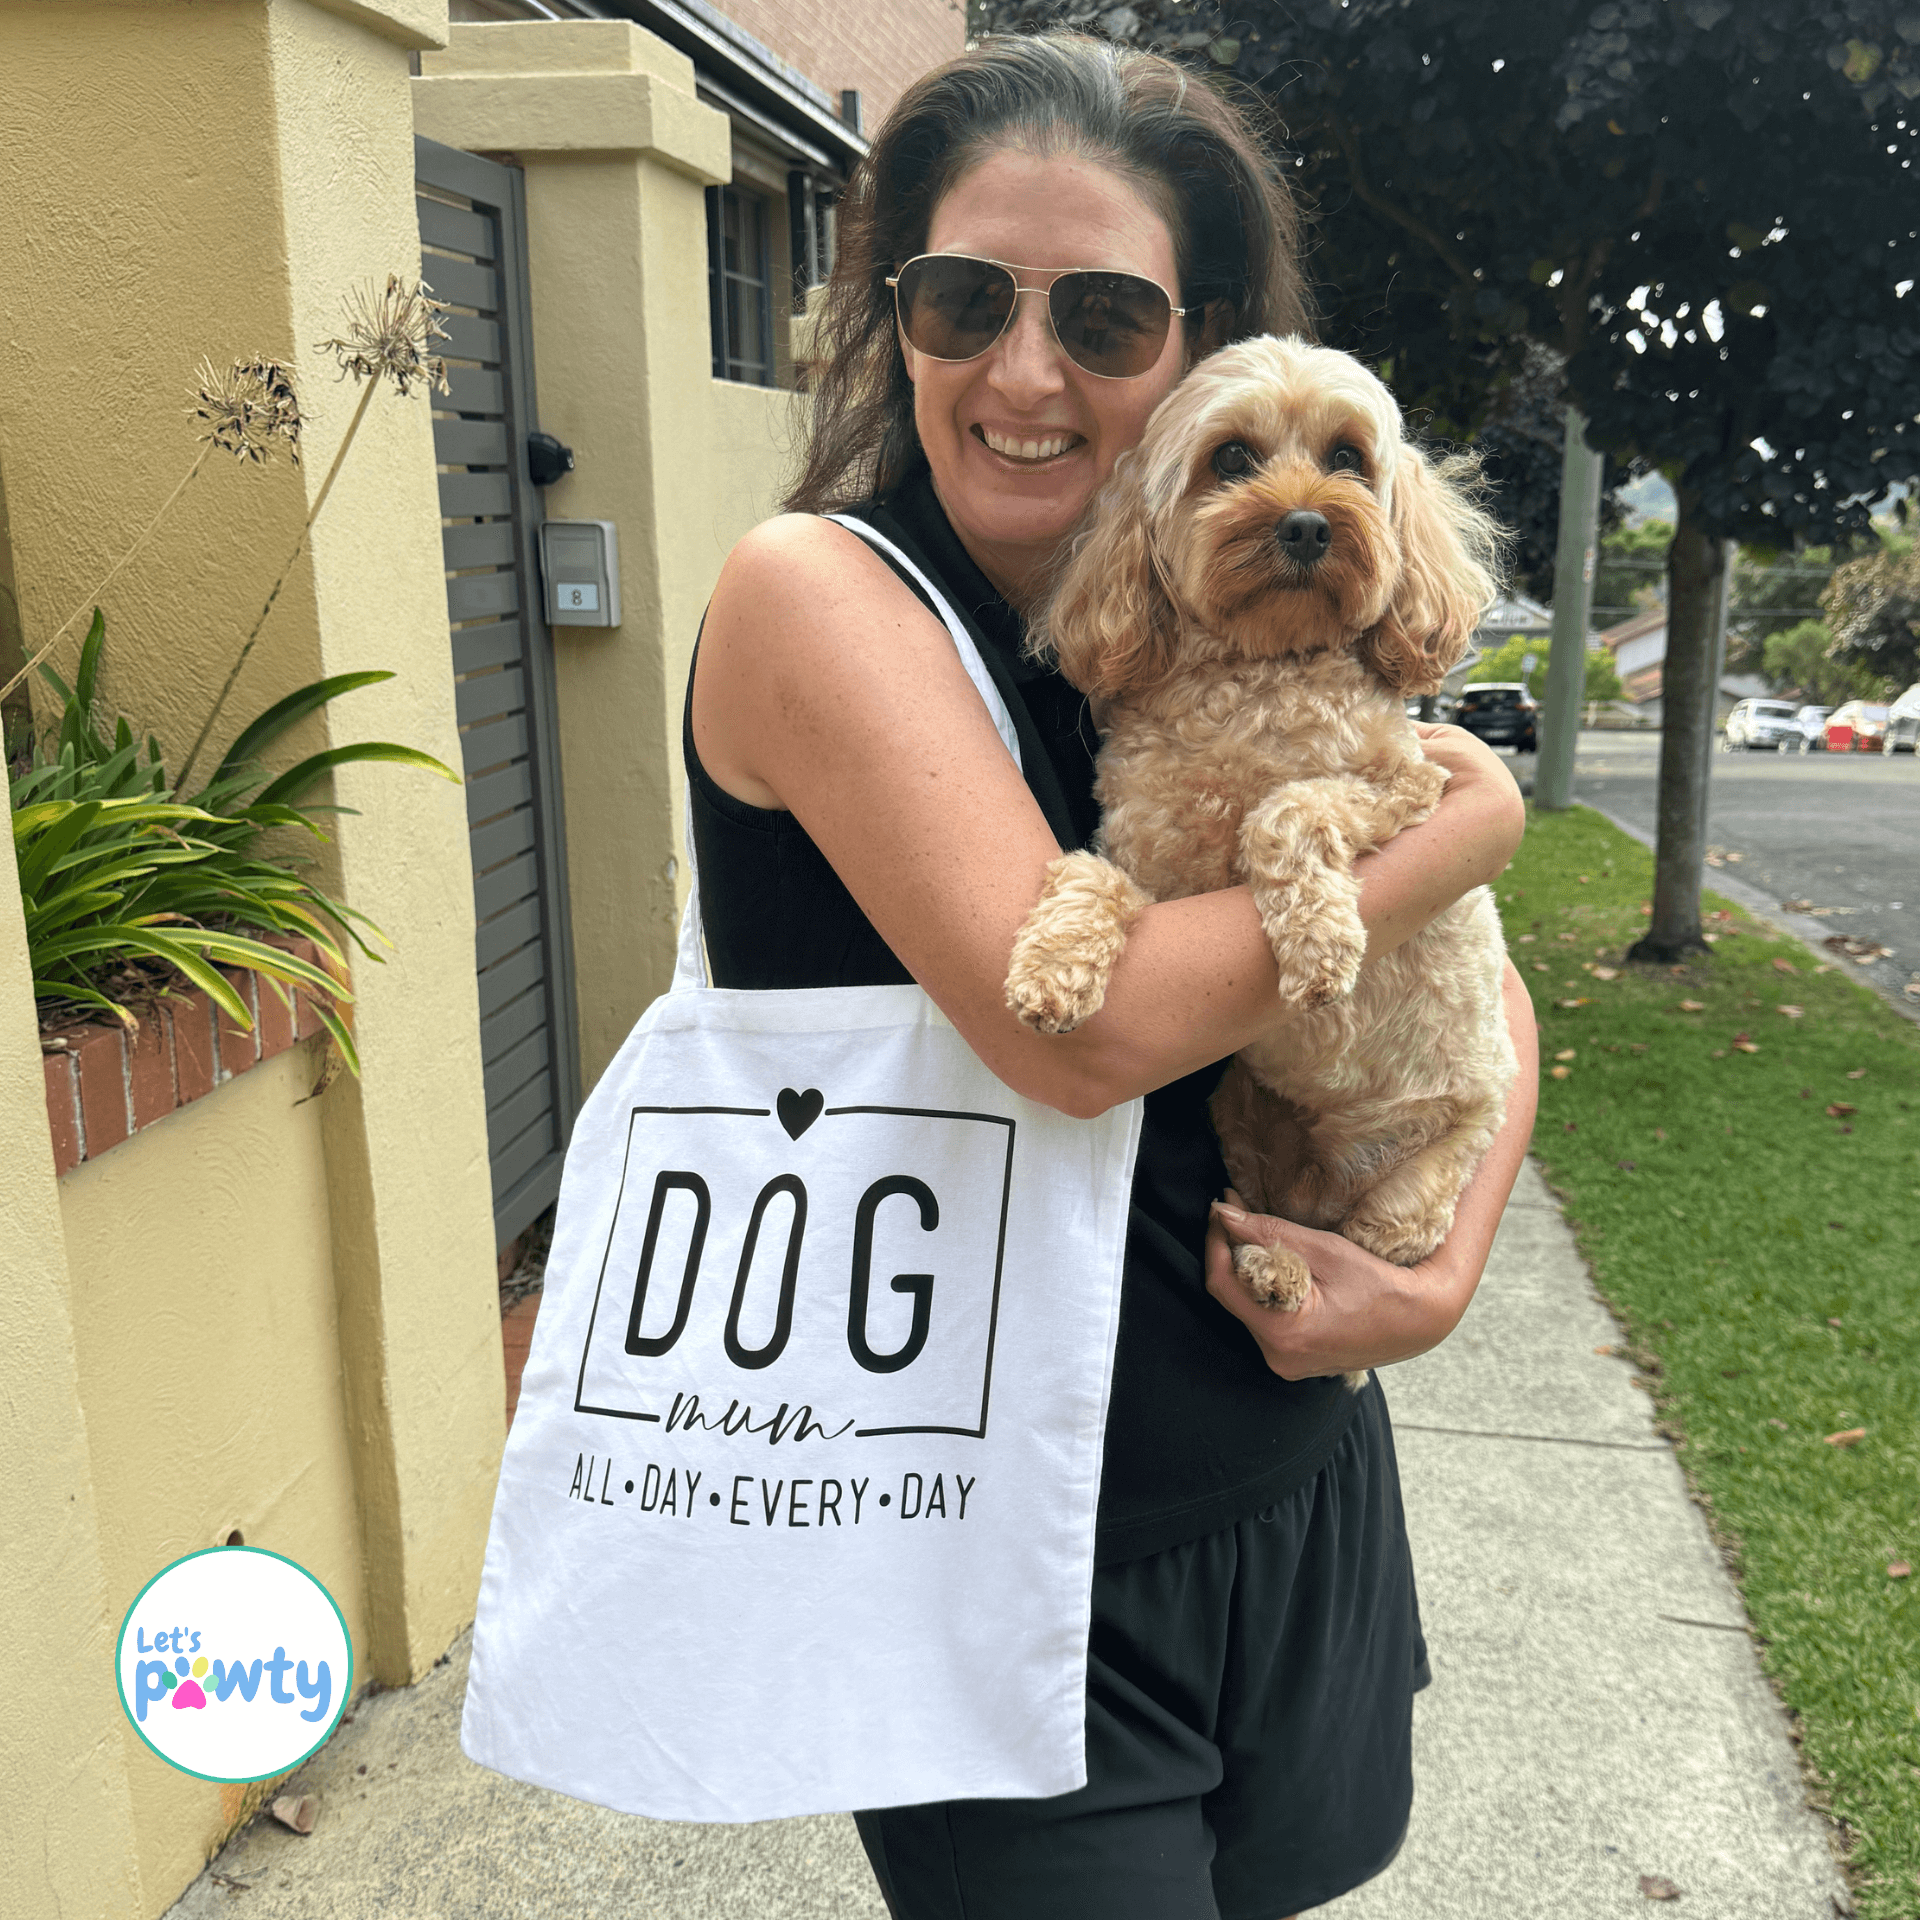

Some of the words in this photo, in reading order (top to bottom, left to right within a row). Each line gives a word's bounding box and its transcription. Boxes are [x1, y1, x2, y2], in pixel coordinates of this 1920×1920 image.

[571, 588, 583, 606] 8
[624, 1170, 940, 1374] DOG
[665, 1392, 855, 1446] mum
[568, 1452, 615, 1506] ALL
[640, 1463, 702, 1518] DAY
[730, 1475, 870, 1528] EVERY
[900, 1472, 976, 1520] DAY
